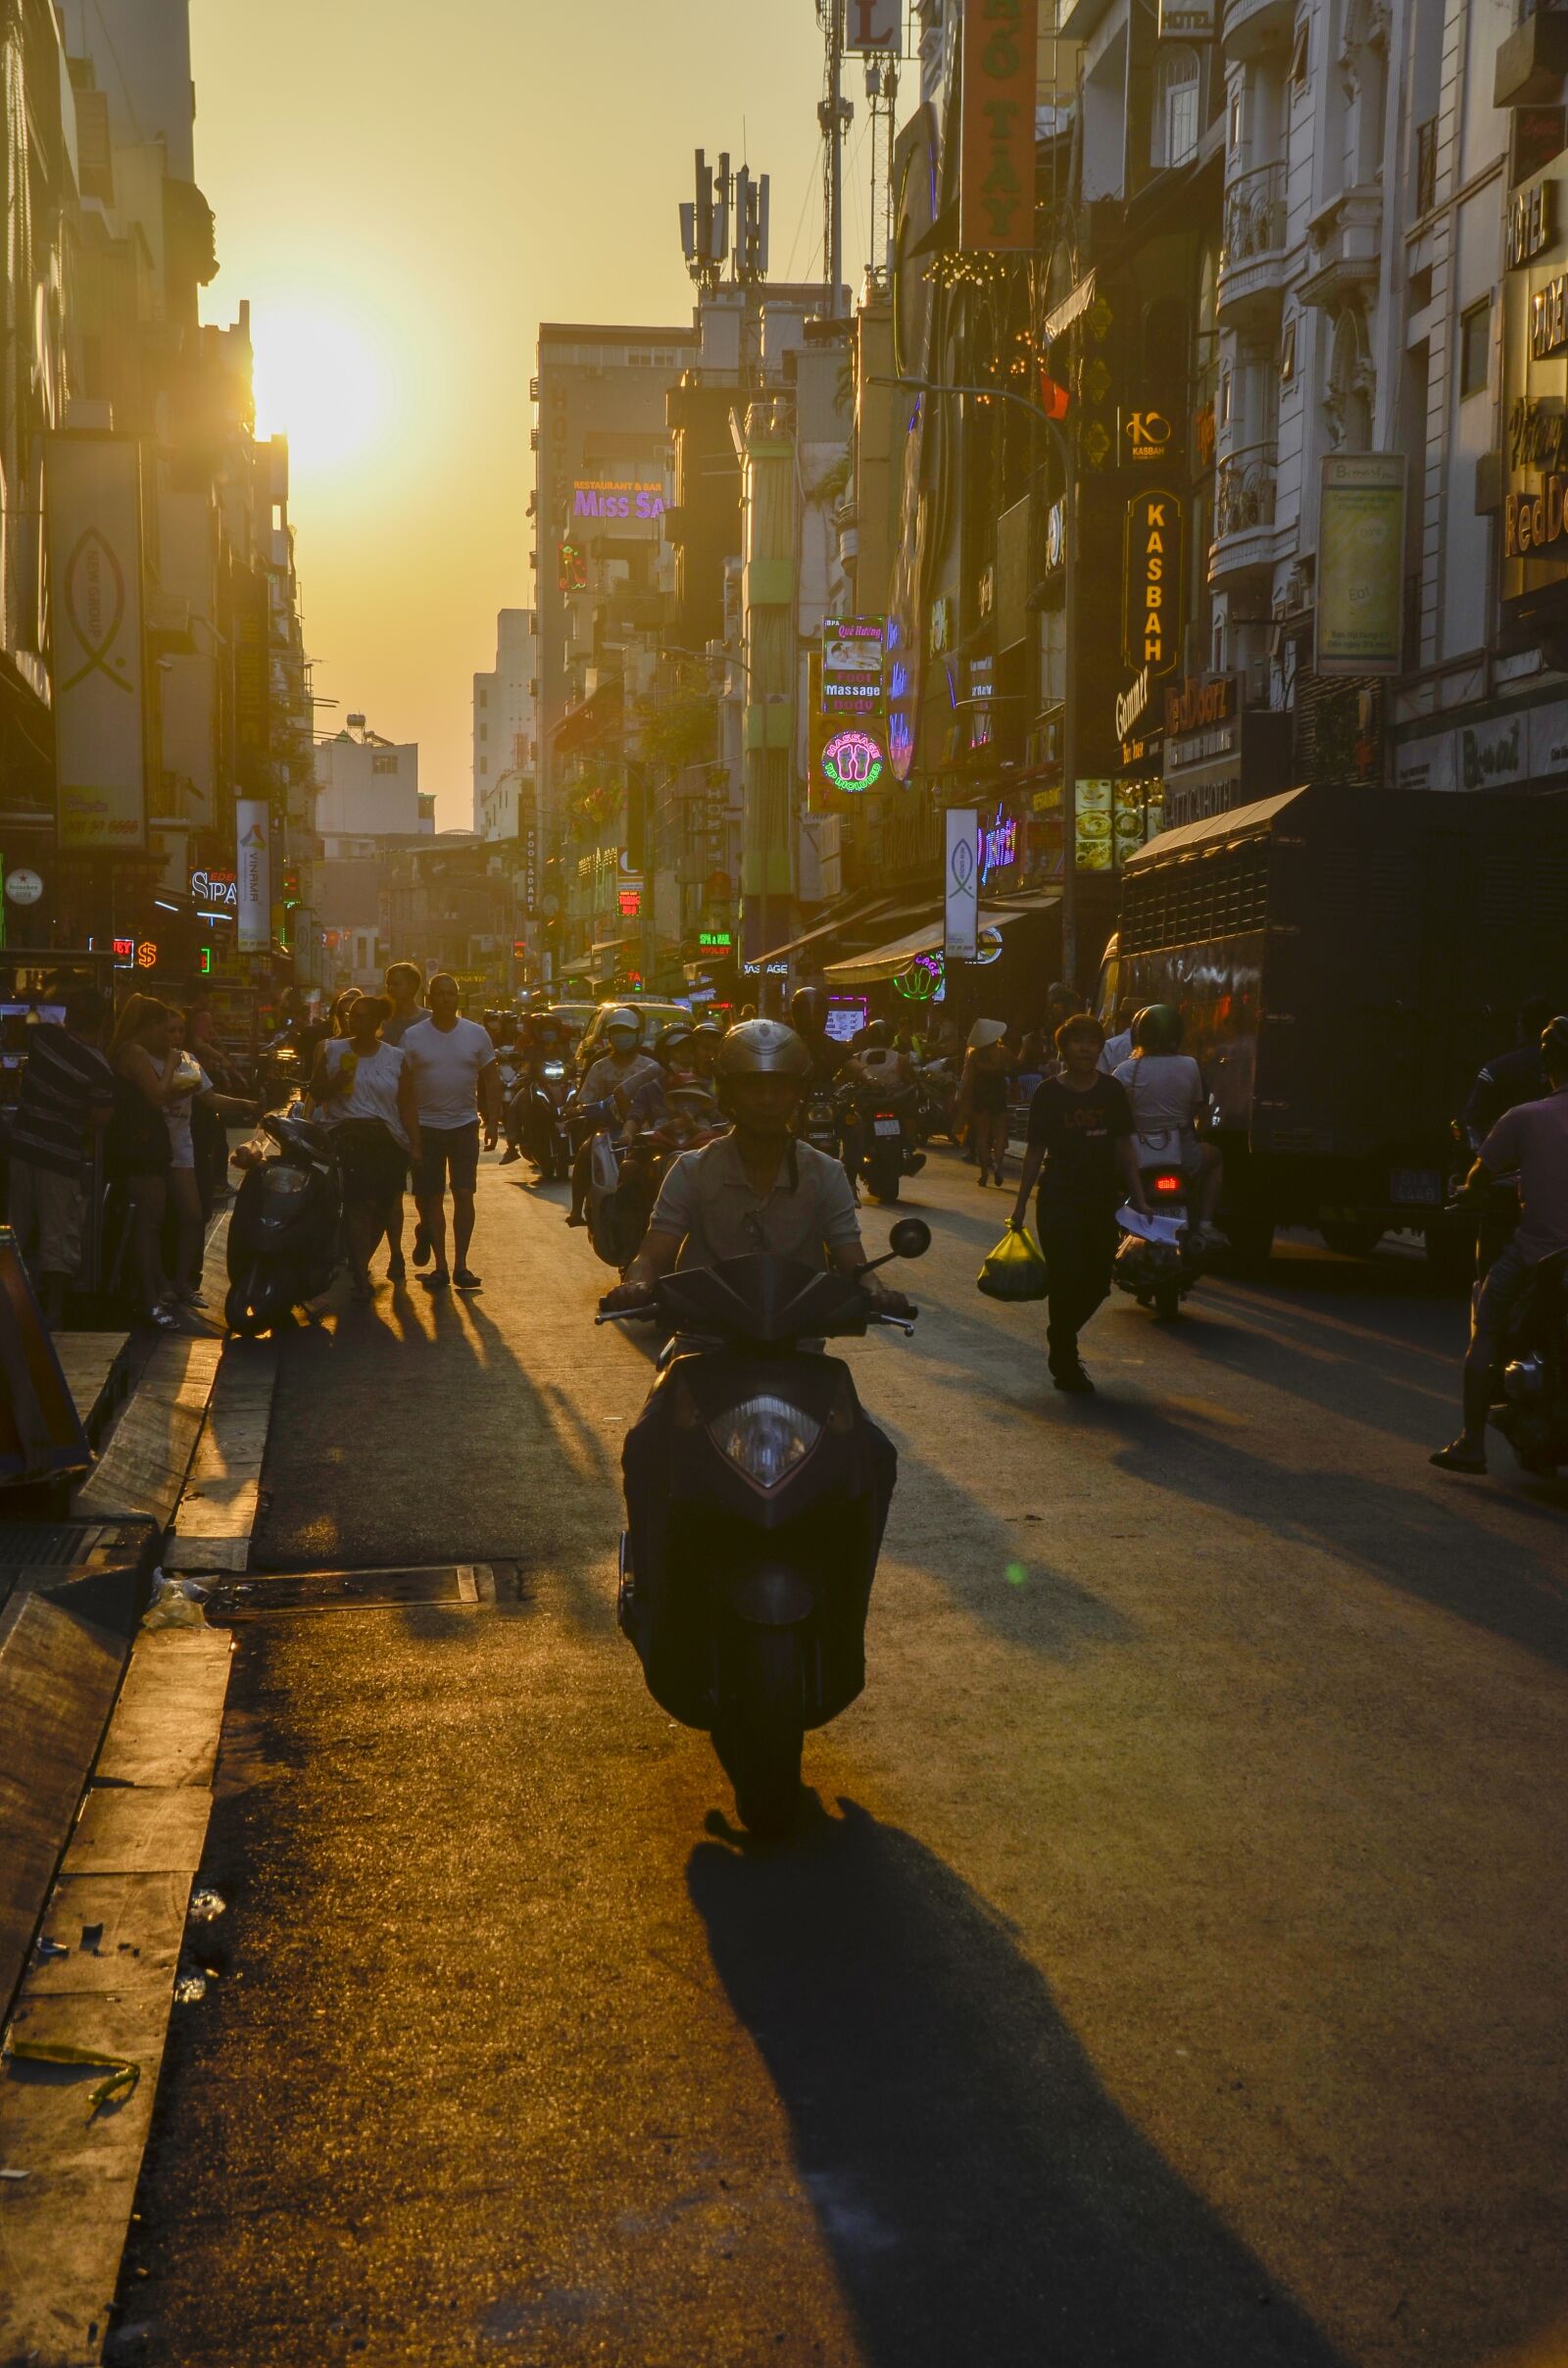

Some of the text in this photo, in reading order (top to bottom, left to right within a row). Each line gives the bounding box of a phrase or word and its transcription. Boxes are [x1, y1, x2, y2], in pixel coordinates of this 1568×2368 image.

[1164, 11, 1215, 29] HOTEL
[982, 100, 1021, 236] TÂY
[1505, 182, 1548, 271] HOTEL
[1132, 446, 1164, 456] KASBAH
[574, 490, 630, 518] MISS
[86, 550, 102, 638] NEW GROUP
[1145, 503, 1165, 662] KASBAH
[1348, 586, 1371, 603] Eat
[826, 684, 880, 697] Massage
[826, 733, 881, 759] MASSAGE
[824, 762, 882, 791] TIP INCLUDED
[192, 871, 237, 905] SPA
[249, 853, 260, 902] VINAMA
[743, 963, 788, 974] ASAGE
